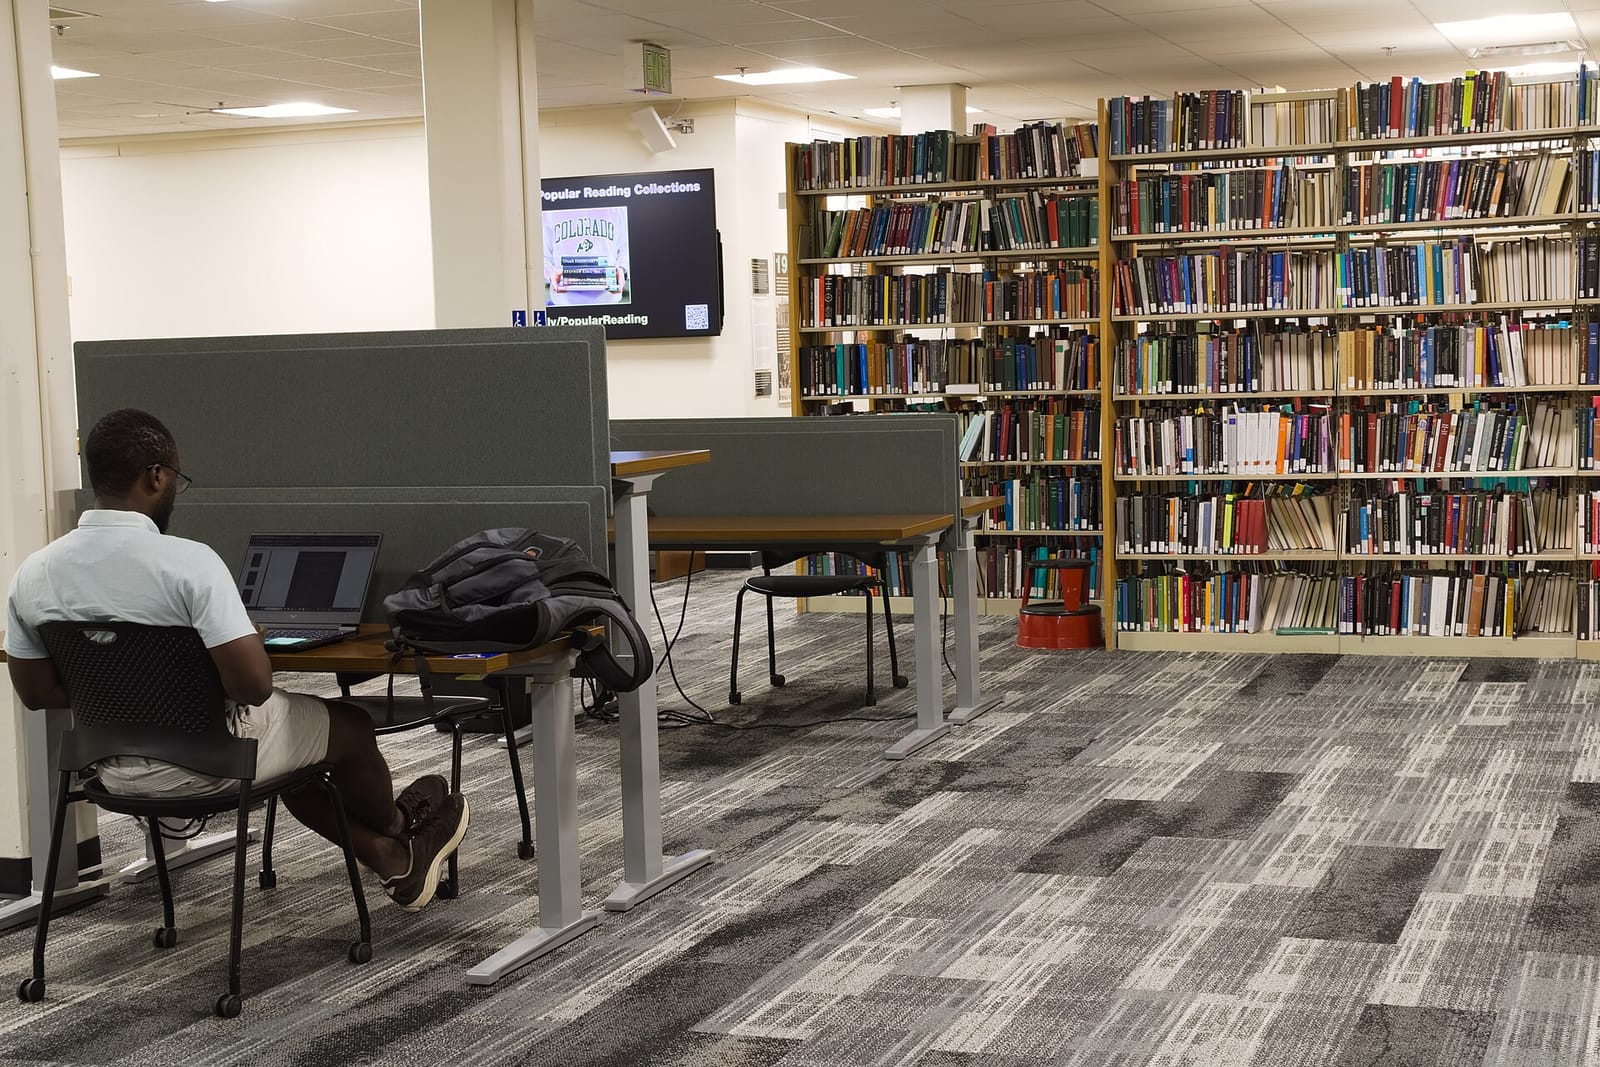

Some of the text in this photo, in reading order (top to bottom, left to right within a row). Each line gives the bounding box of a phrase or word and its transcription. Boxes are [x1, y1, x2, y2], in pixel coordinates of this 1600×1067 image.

[583, 185, 631, 198] Reading
[634, 182, 701, 195] Collections
[554, 217, 614, 244] COLORADO
